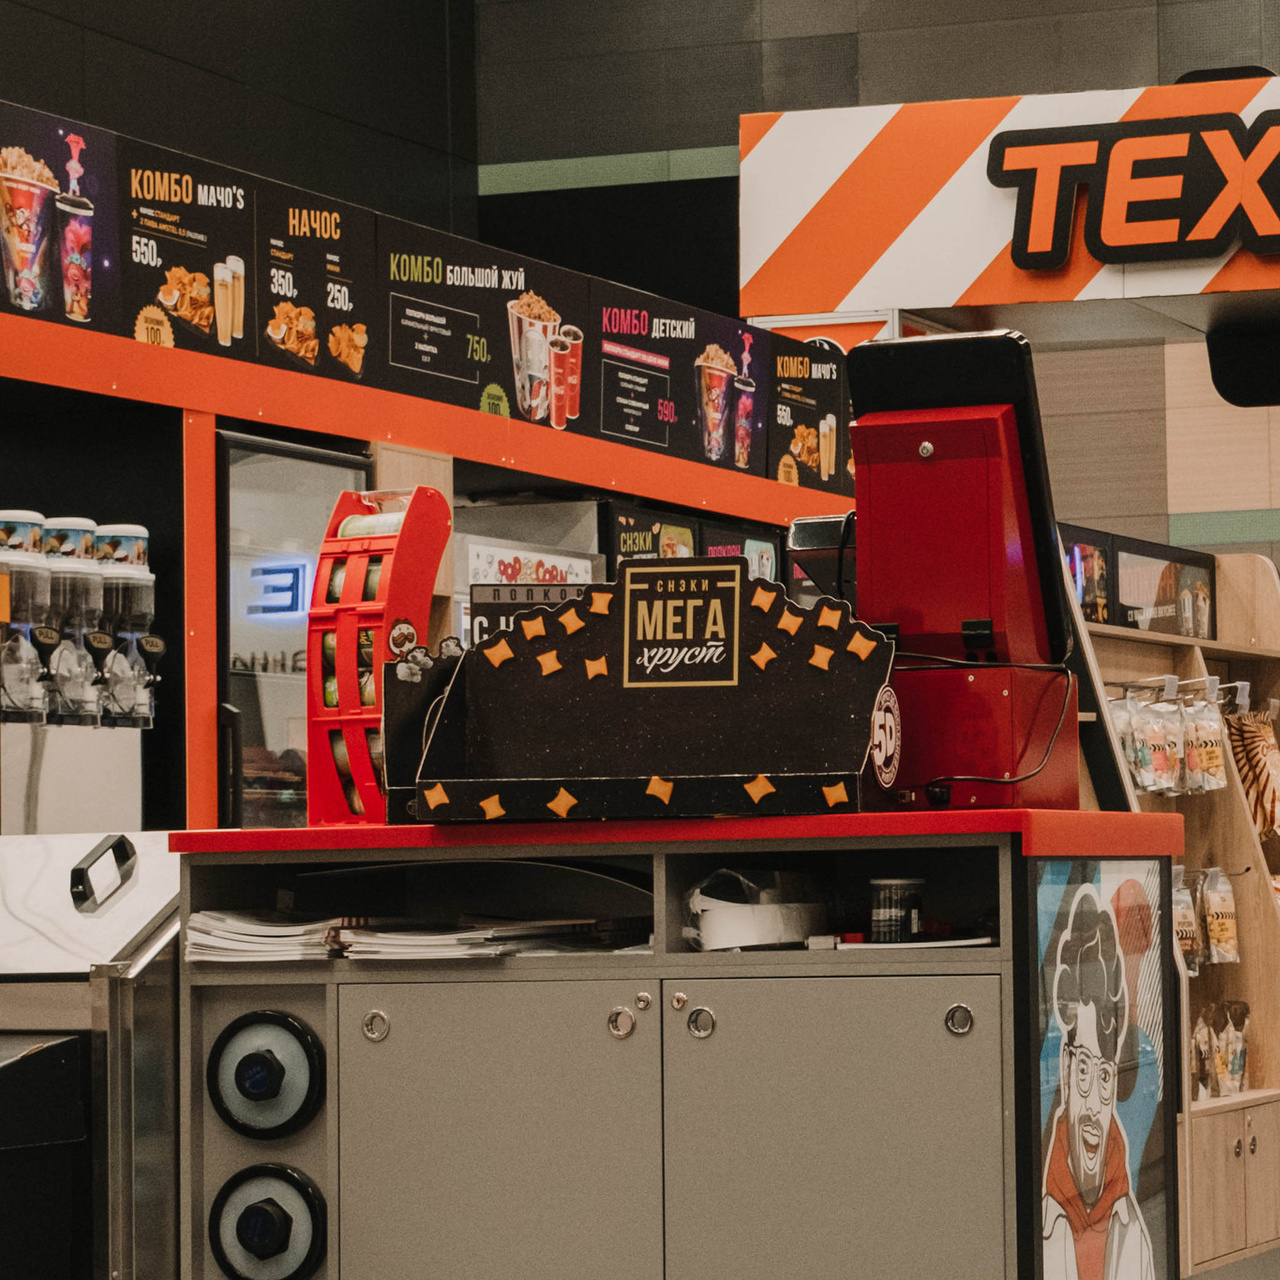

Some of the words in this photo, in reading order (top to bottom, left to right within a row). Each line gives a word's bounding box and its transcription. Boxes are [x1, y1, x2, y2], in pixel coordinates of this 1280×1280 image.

[130, 168, 193, 204] КОМБО
[197, 184, 245, 209] МАЧО'S
[288, 207, 341, 240] НАЧОС
[390, 253, 442, 284] КОМБО
[446, 265, 498, 289] БОЛЬШОЙ
[501, 267, 525, 290] ЖУЙ
[602, 307, 649, 336] КОМБО
[651, 317, 695, 339] ДЕТСКИЙ
[777, 356, 810, 379] КОМБО
[620, 531, 652, 553] СНЭКИ
[498, 556, 521, 583] POP
[656, 578, 709, 593] СНЭКИ
[493, 586, 584, 602] ПОПКОР
[636, 598, 726, 641] МЕГА
[636, 641, 727, 675] хруст
[873, 711, 896, 766] 5D
